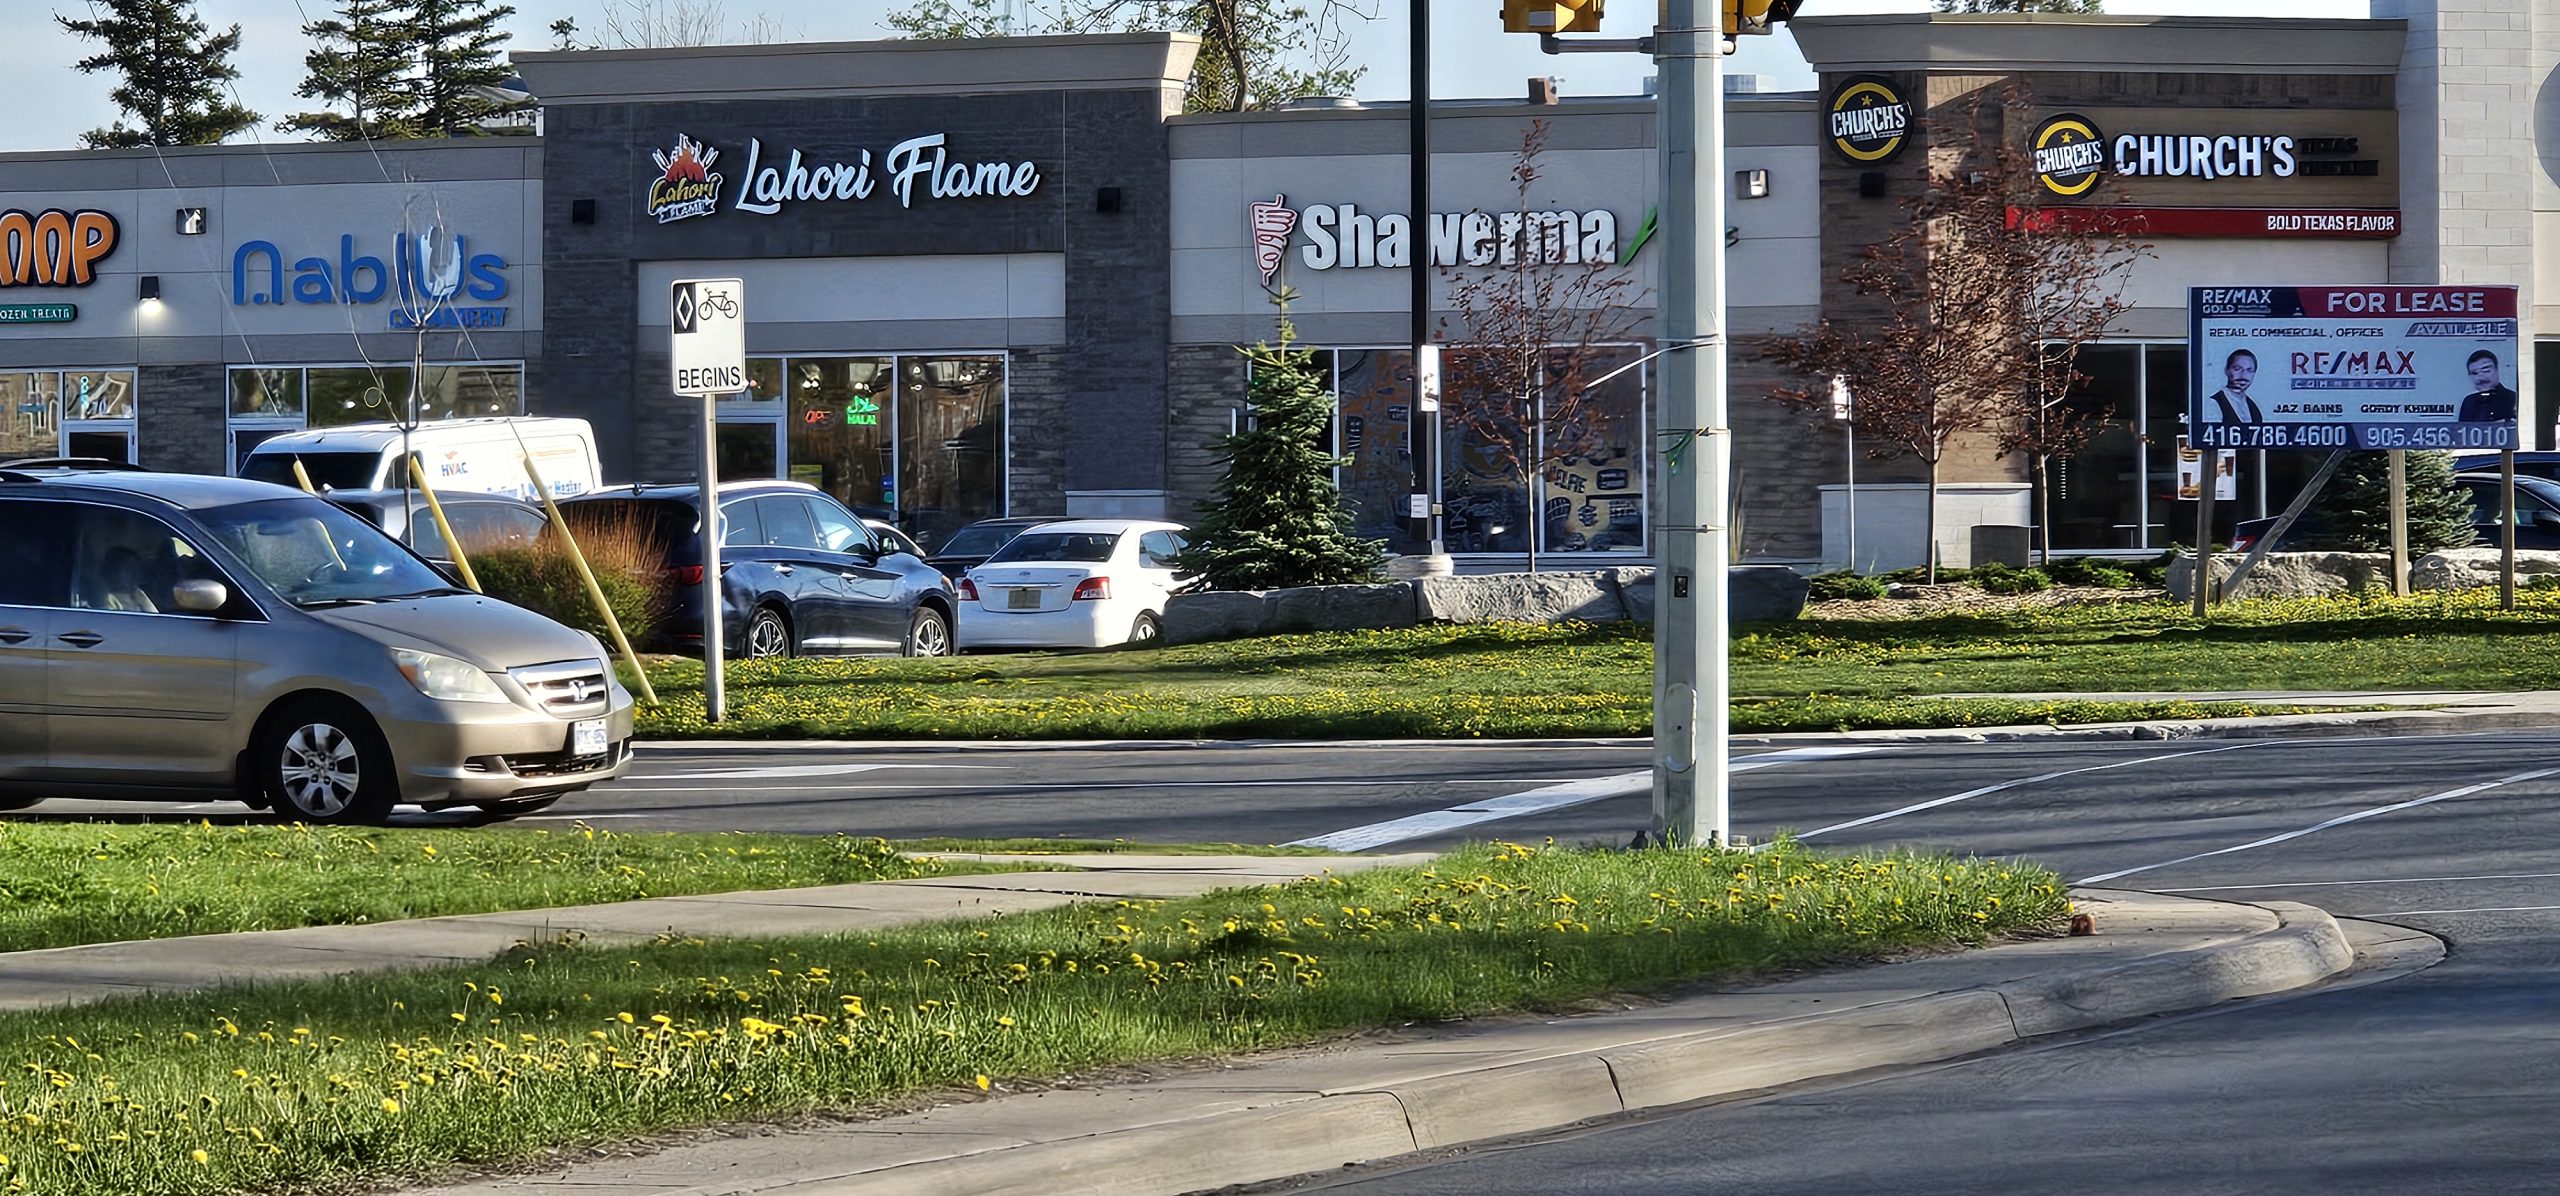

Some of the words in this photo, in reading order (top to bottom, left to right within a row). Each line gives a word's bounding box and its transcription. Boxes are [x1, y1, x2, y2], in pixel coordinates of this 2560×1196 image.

[2114, 134, 2295, 180] CHURCH'S
[736, 136, 875, 214] Lahori
[886, 132, 1040, 208] Flame
[2267, 214, 2301, 231] BOLD
[2302, 214, 2345, 231] TEXAS
[2345, 215, 2396, 232] FLAVOR
[1301, 203, 1617, 271] Shawerma
[2202, 289, 2273, 304] RE/MAX
[2327, 292, 2386, 313] FOR
[2395, 292, 2485, 313] LEASE
[2414, 322, 2508, 336] AVAILABLE
[2291, 350, 2416, 375] RE/MAX
[679, 366, 741, 389] BEGINS
[2273, 404, 2299, 413] JAZ
[2367, 427, 2508, 447] 905.456.1010
[441, 462, 469, 476] HVAC
